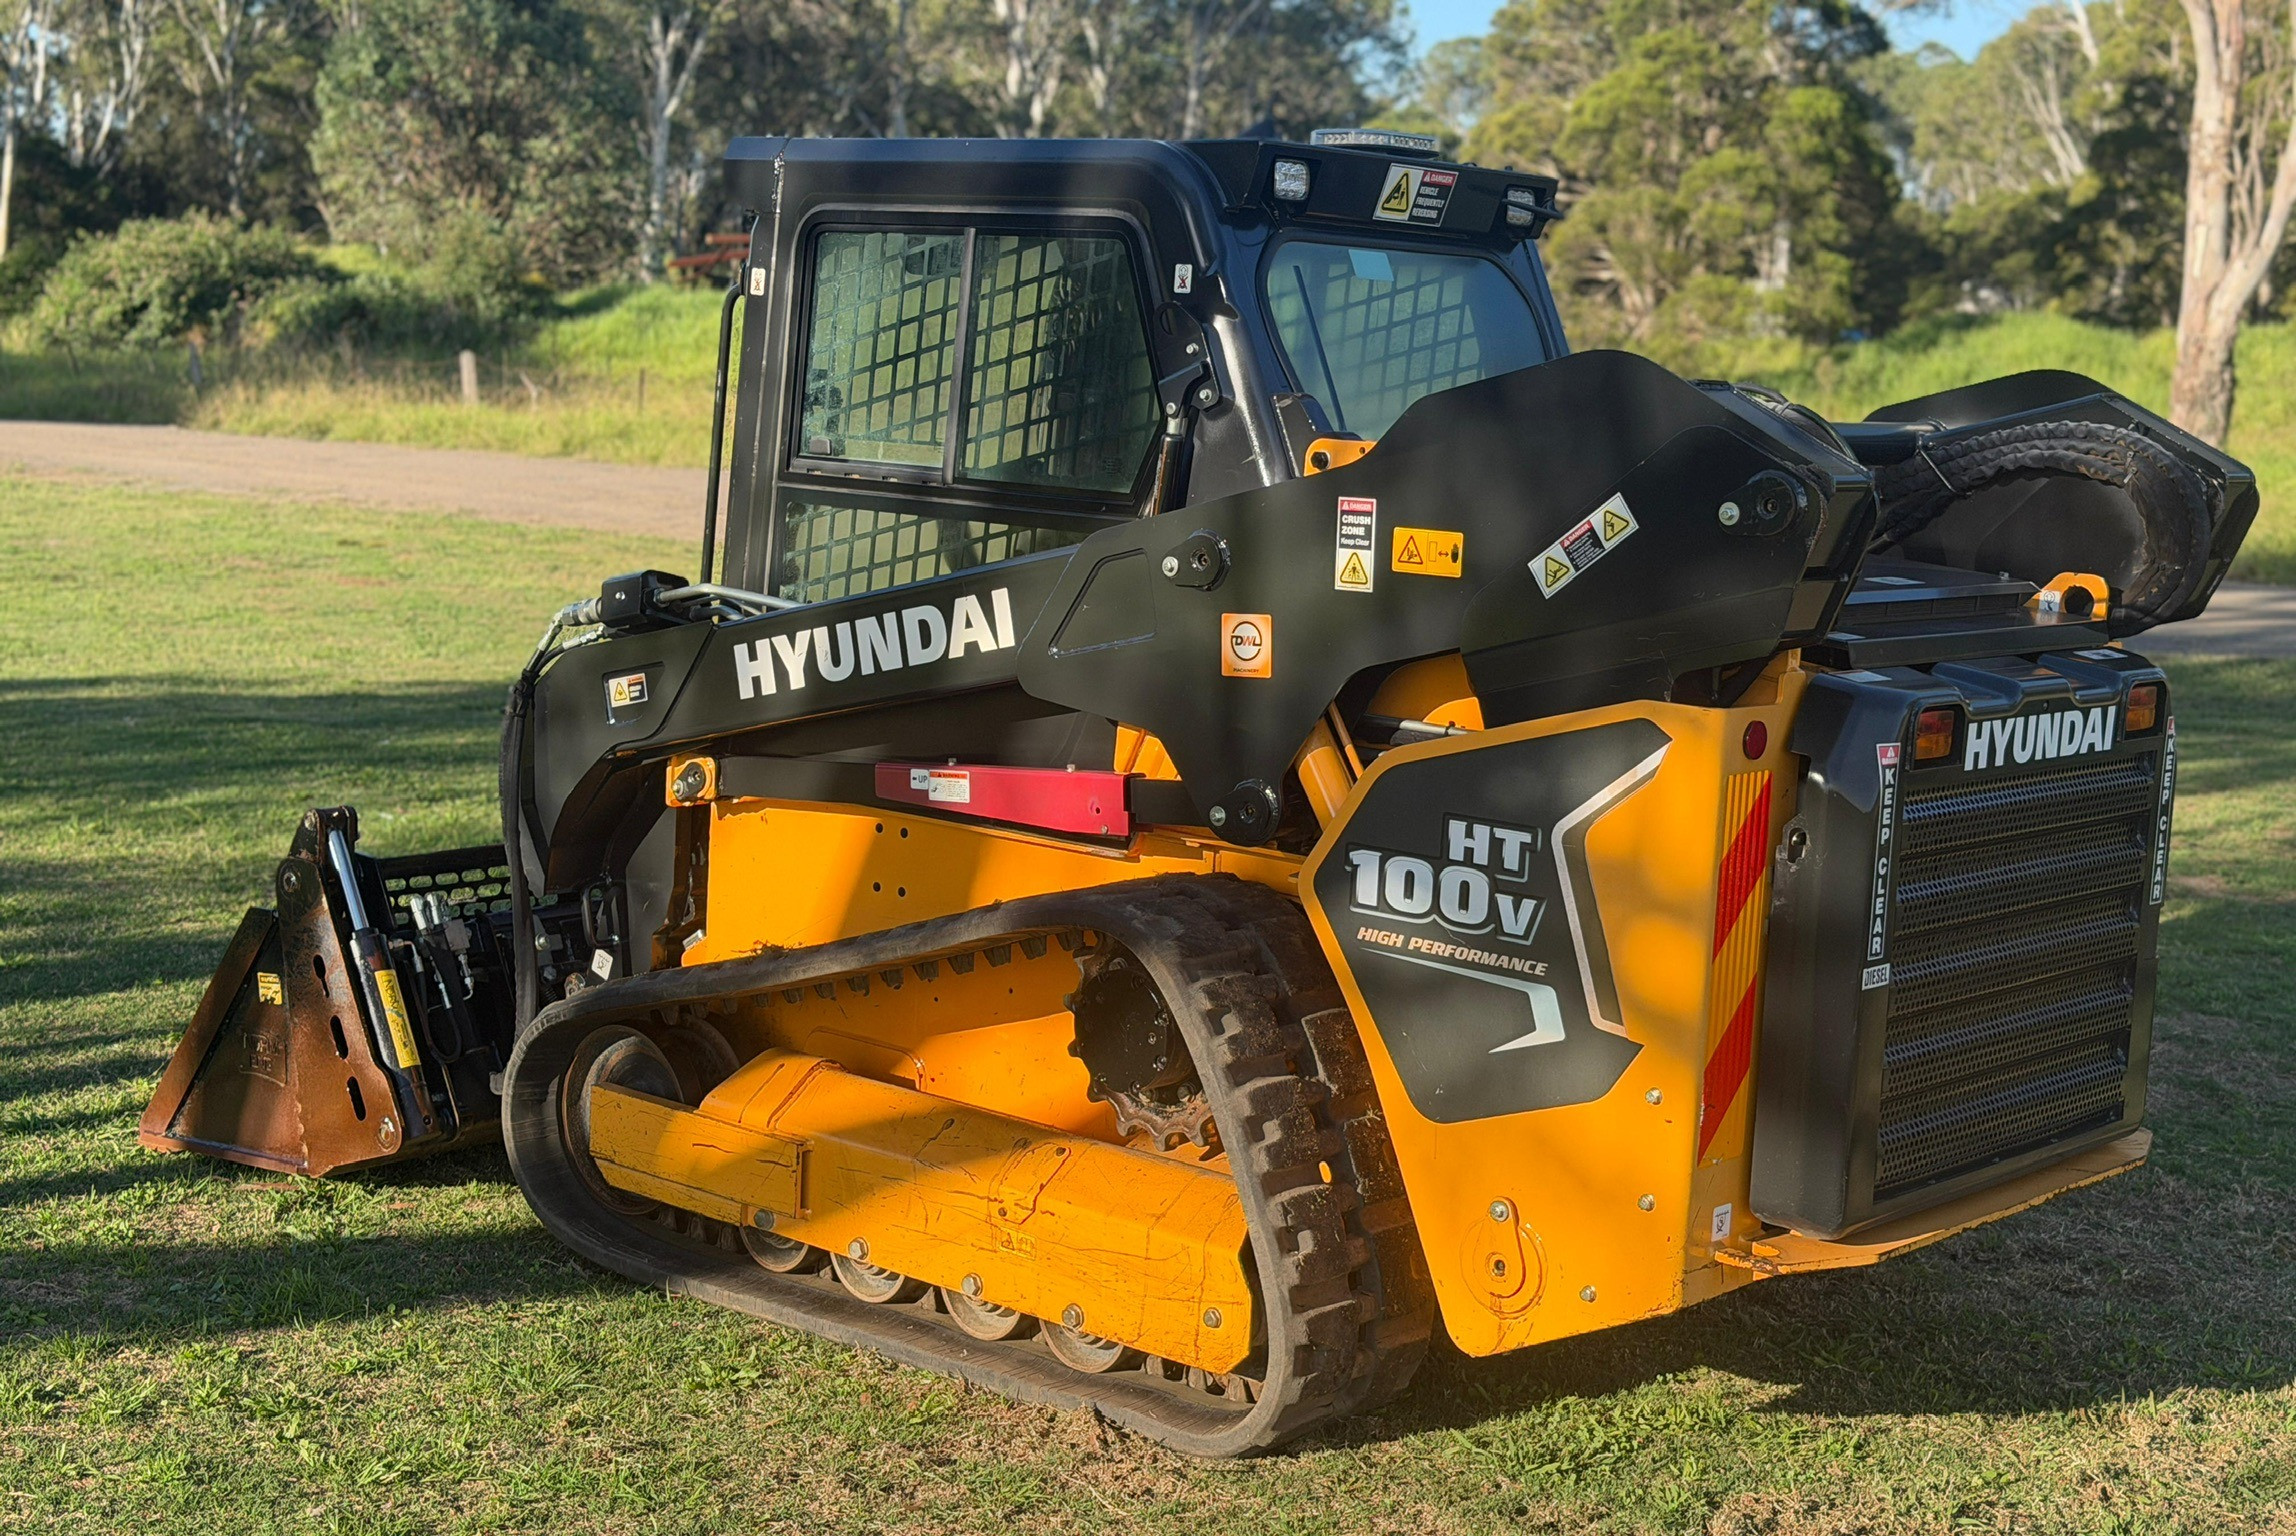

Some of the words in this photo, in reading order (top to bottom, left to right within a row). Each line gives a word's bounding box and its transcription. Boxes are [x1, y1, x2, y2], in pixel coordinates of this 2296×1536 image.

[1430, 173, 1453, 184] DANGER
[1419, 186, 1439, 196] VEHICLE
[1415, 197, 1445, 208] FREQUENTLY
[1411, 208, 1438, 219] REVERSING
[1349, 502, 1372, 512] DANGER
[1341, 515, 1371, 525] CRUSH
[1341, 526, 1365, 535] ZONE
[1340, 537, 1354, 546] Keep
[1355, 538, 1370, 547] Clear
[733, 587, 1015, 700] HYUNDAI
[1231, 635, 1262, 647] DWL
[1964, 705, 2117, 771] HYUNDAI
[2161, 738, 2175, 805] KEEP
[917, 774, 928, 784] UP
[1880, 767, 1896, 845] KEEP
[1448, 819, 1533, 872] HT
[2152, 815, 2168, 899] CLEAR
[1871, 857, 1888, 954] CLEAR
[1356, 926, 1405, 948] HIGH
[1407, 936, 1549, 976] PERFORMANCE
[1864, 965, 1888, 987] DIESEL
